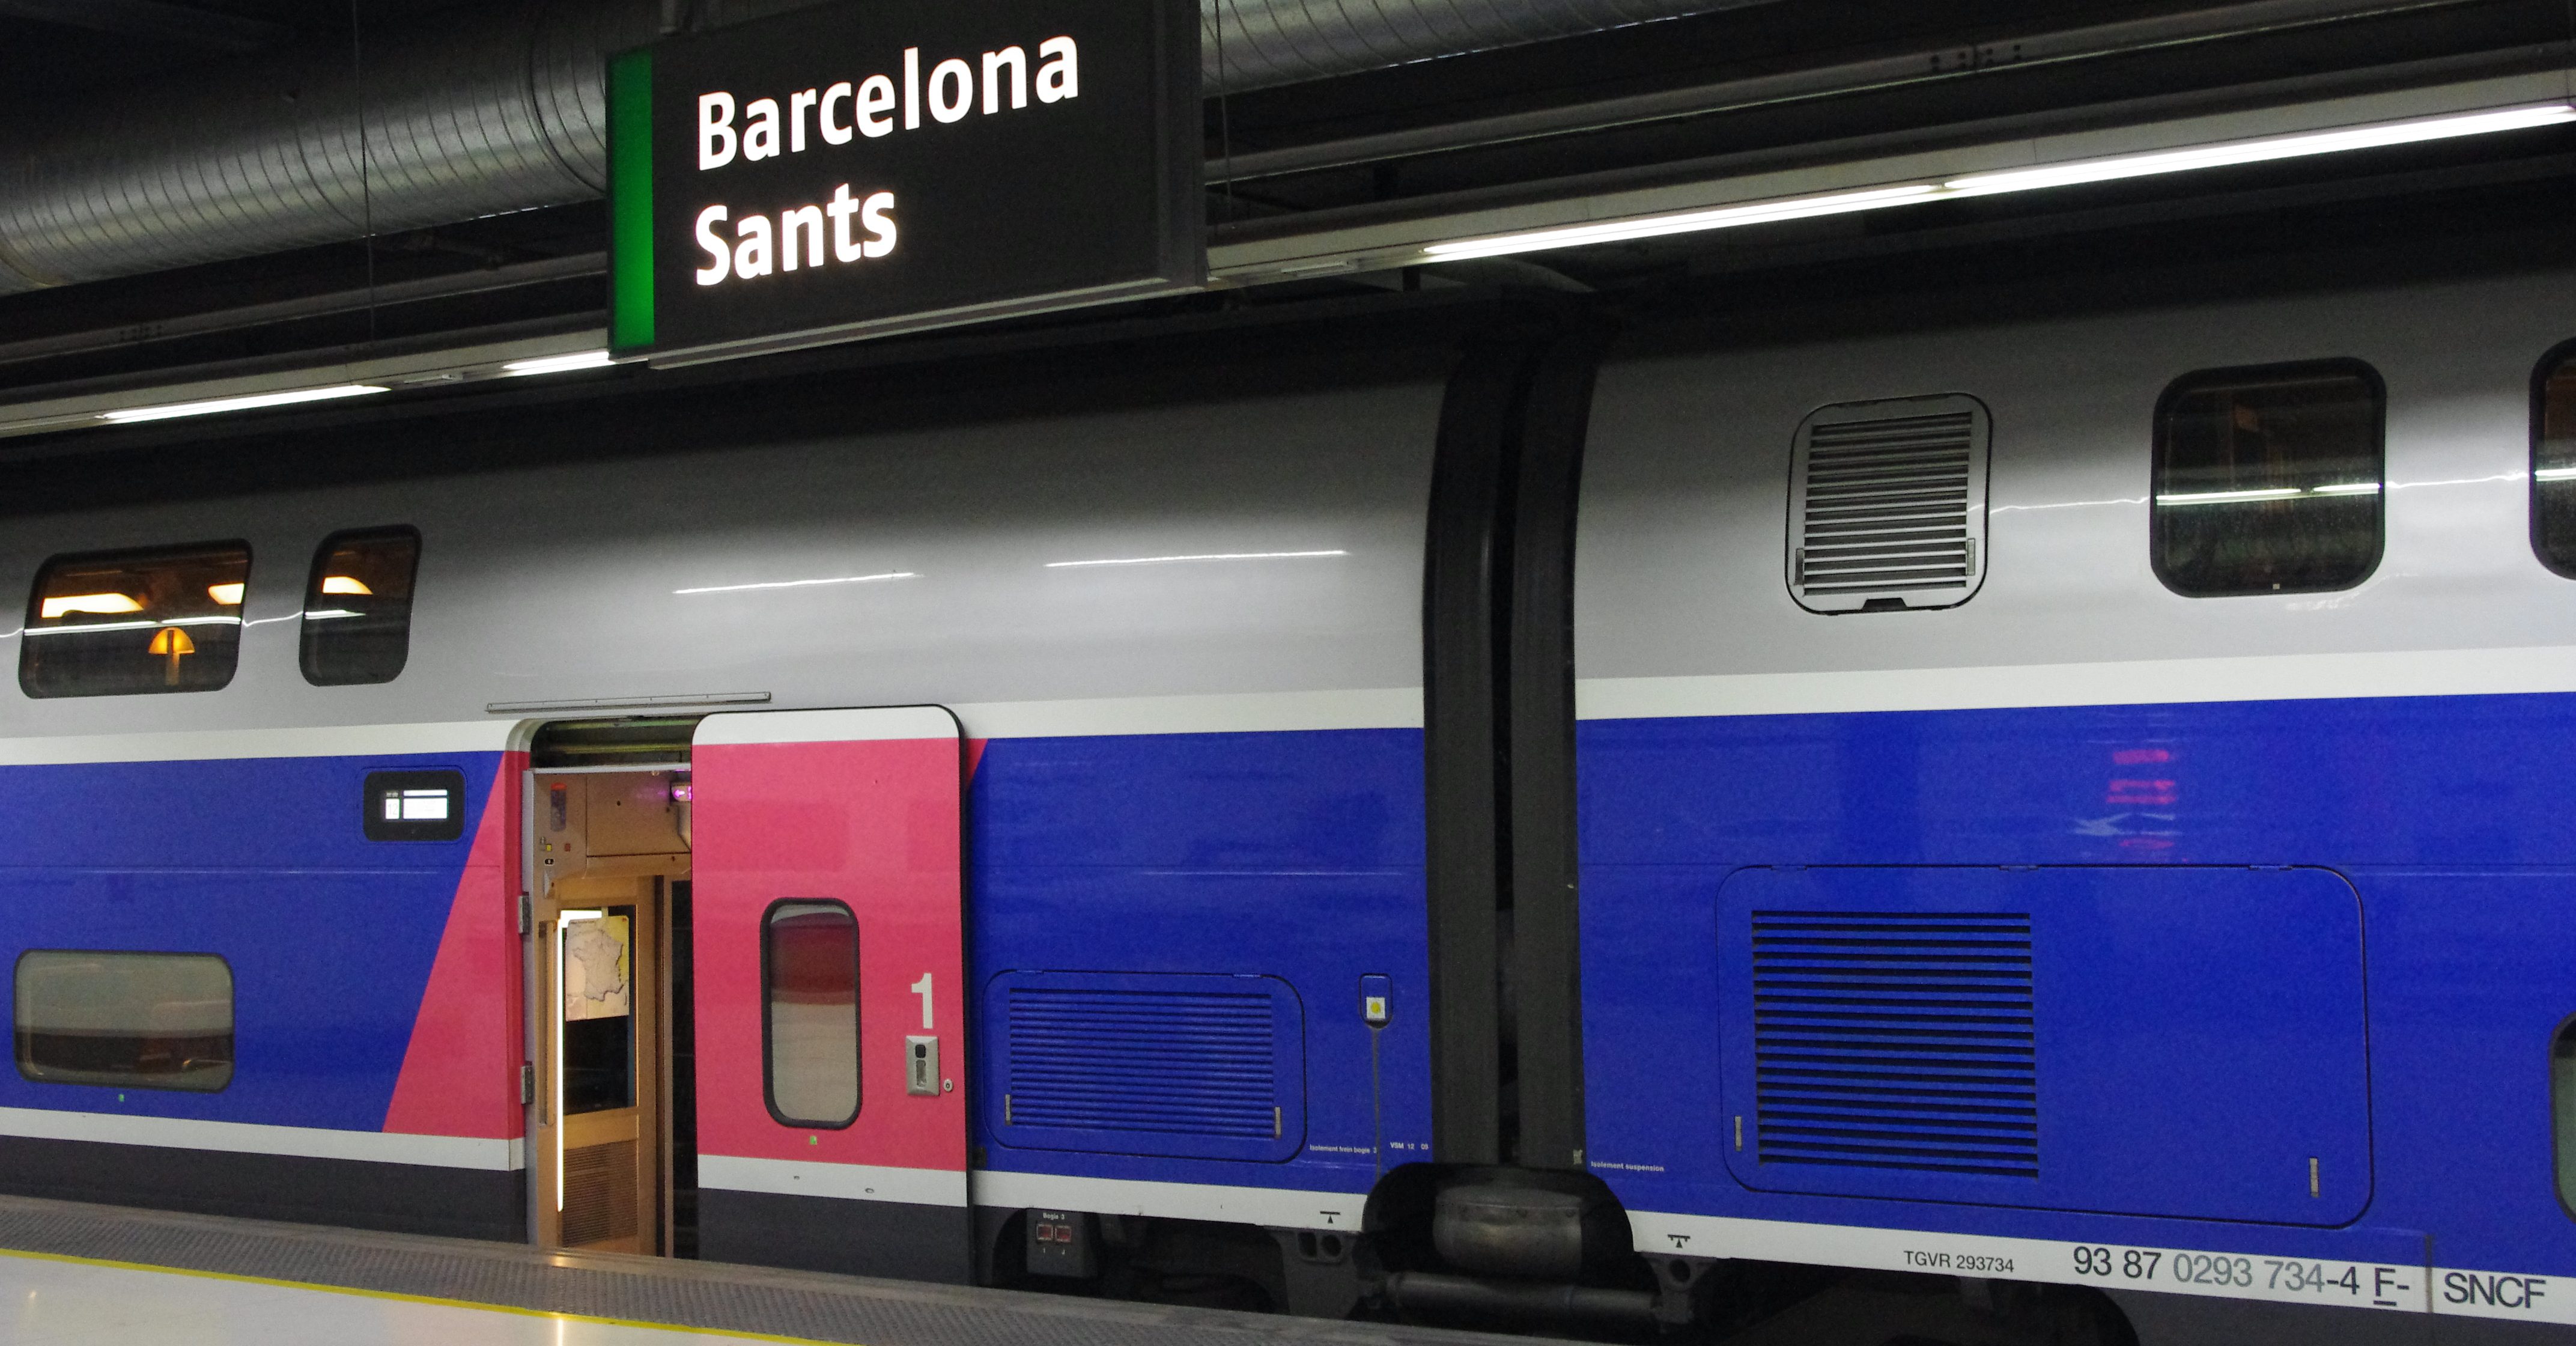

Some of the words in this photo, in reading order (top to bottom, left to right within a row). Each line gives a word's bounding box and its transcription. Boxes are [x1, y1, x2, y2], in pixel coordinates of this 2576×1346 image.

[698, 35, 1079, 171] Barcelona
[695, 183, 897, 287] Sants
[911, 972, 933, 1029] 1
[1310, 1143, 1338, 1152] Isolement
[1591, 1161, 1624, 1170] Isolement
[1625, 1163, 1664, 1172] suspension
[1903, 1250, 1951, 1268] TGVR
[1956, 1255, 2014, 1273] 293734
[2073, 1246, 2112, 1276] 93
[2122, 1250, 2161, 1279] 87
[2173, 1253, 2252, 1288] 0293
[2264, 1260, 2360, 1296] 734-4
[2443, 1272, 2547, 1309] SNCF
